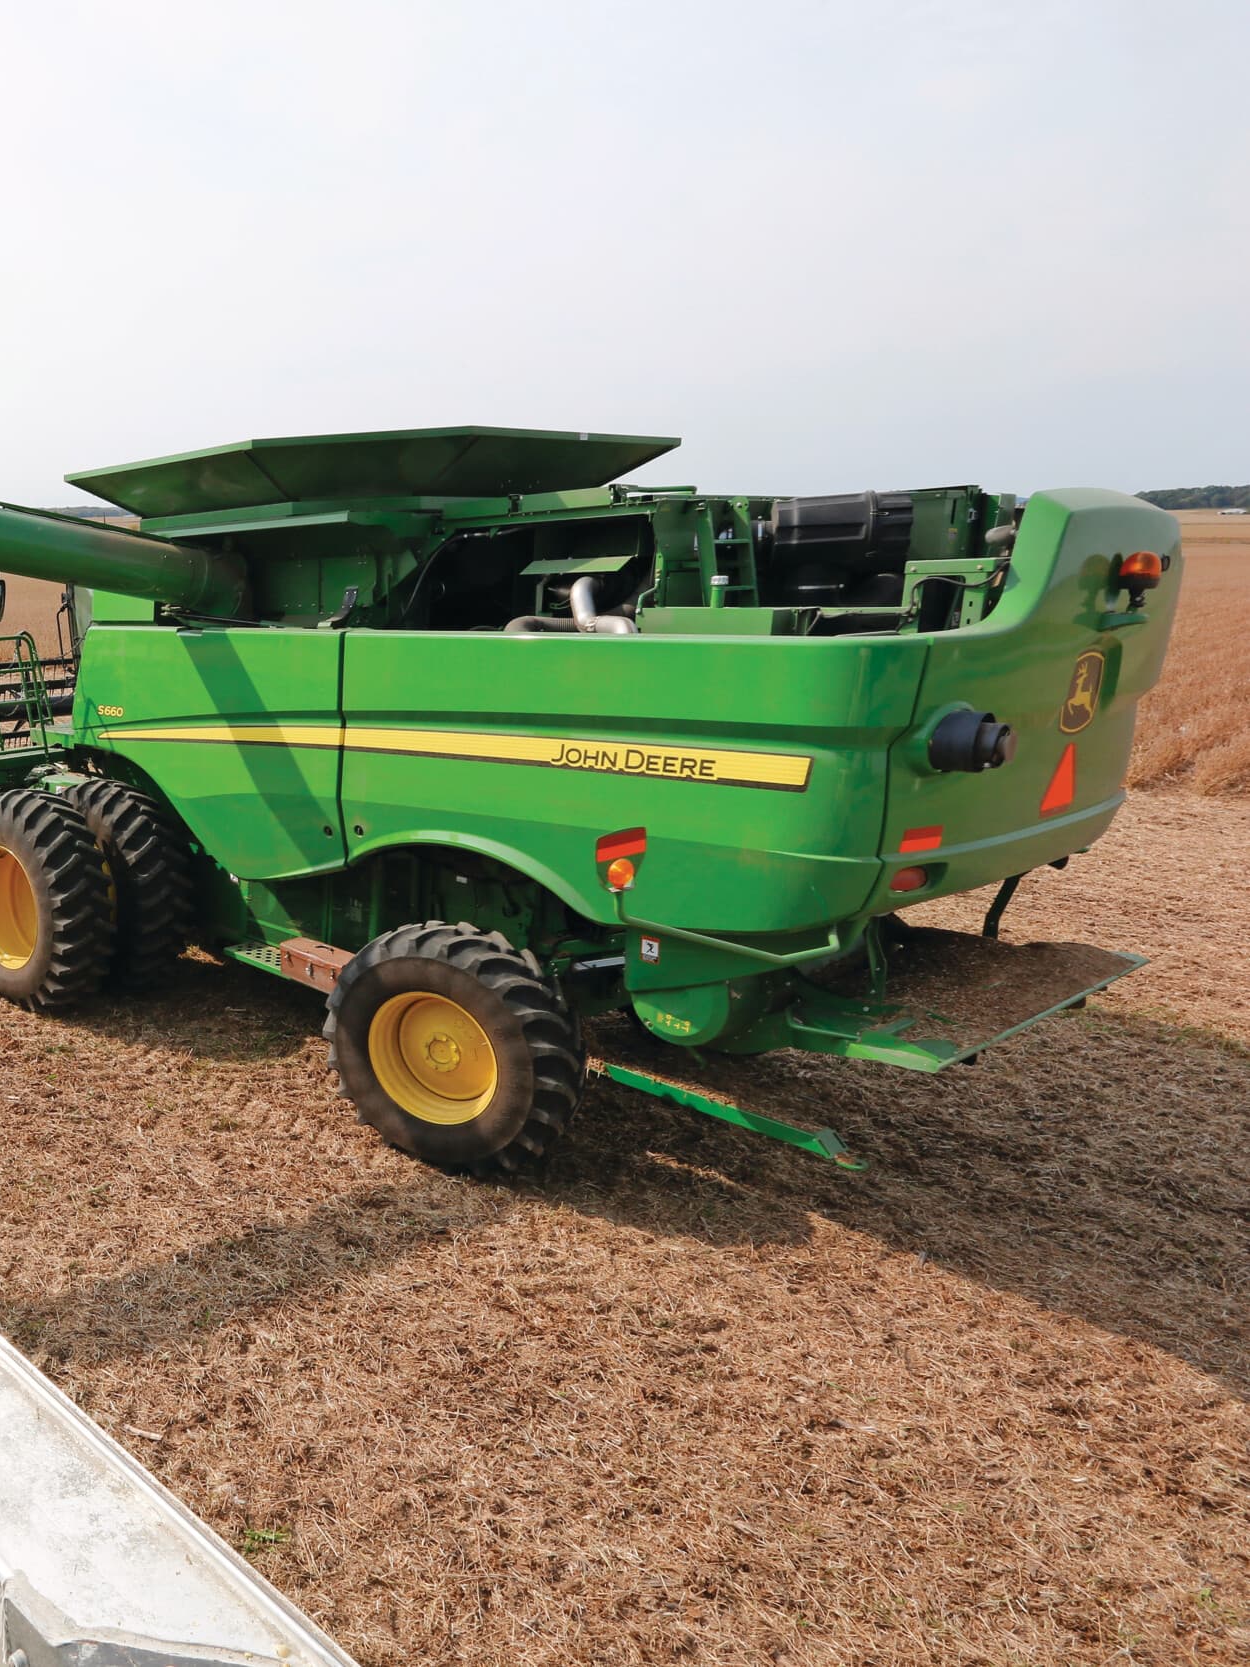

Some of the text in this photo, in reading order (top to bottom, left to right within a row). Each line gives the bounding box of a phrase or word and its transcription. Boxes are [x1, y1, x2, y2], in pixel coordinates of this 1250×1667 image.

[97, 704, 124, 718] S660
[551, 743, 717, 778] JOHN DEERE
